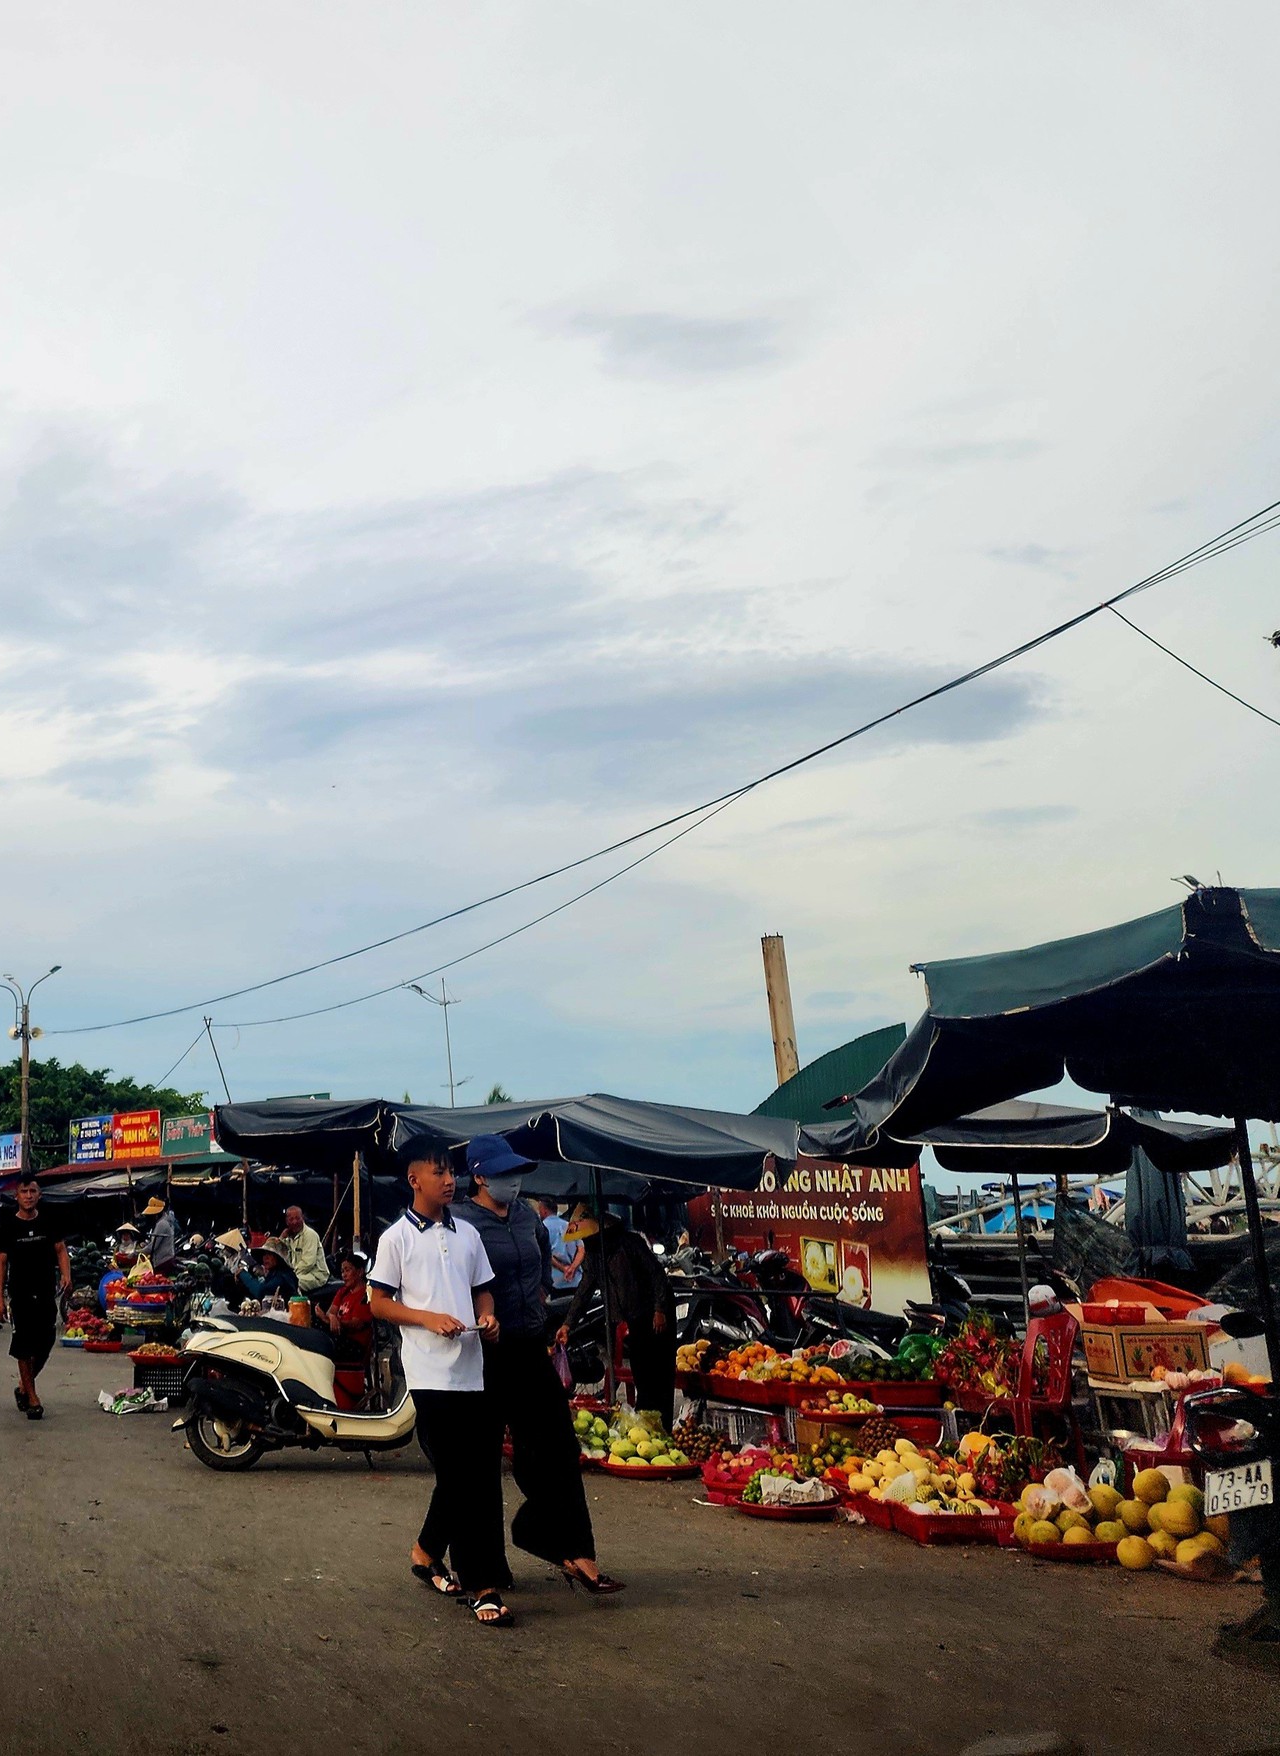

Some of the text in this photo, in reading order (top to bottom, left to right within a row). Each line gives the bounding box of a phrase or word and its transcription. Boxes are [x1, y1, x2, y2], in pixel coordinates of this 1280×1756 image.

[3, 1144, 17, 1160] NGA
[815, 1163, 863, 1198] NHẬT
[868, 1168, 911, 1192] ANH
[756, 1200, 780, 1219] KHỞI
[781, 1200, 818, 1220] NGUỒN
[819, 1202, 850, 1224] CUỘC
[851, 1200, 884, 1222] SỐNG
